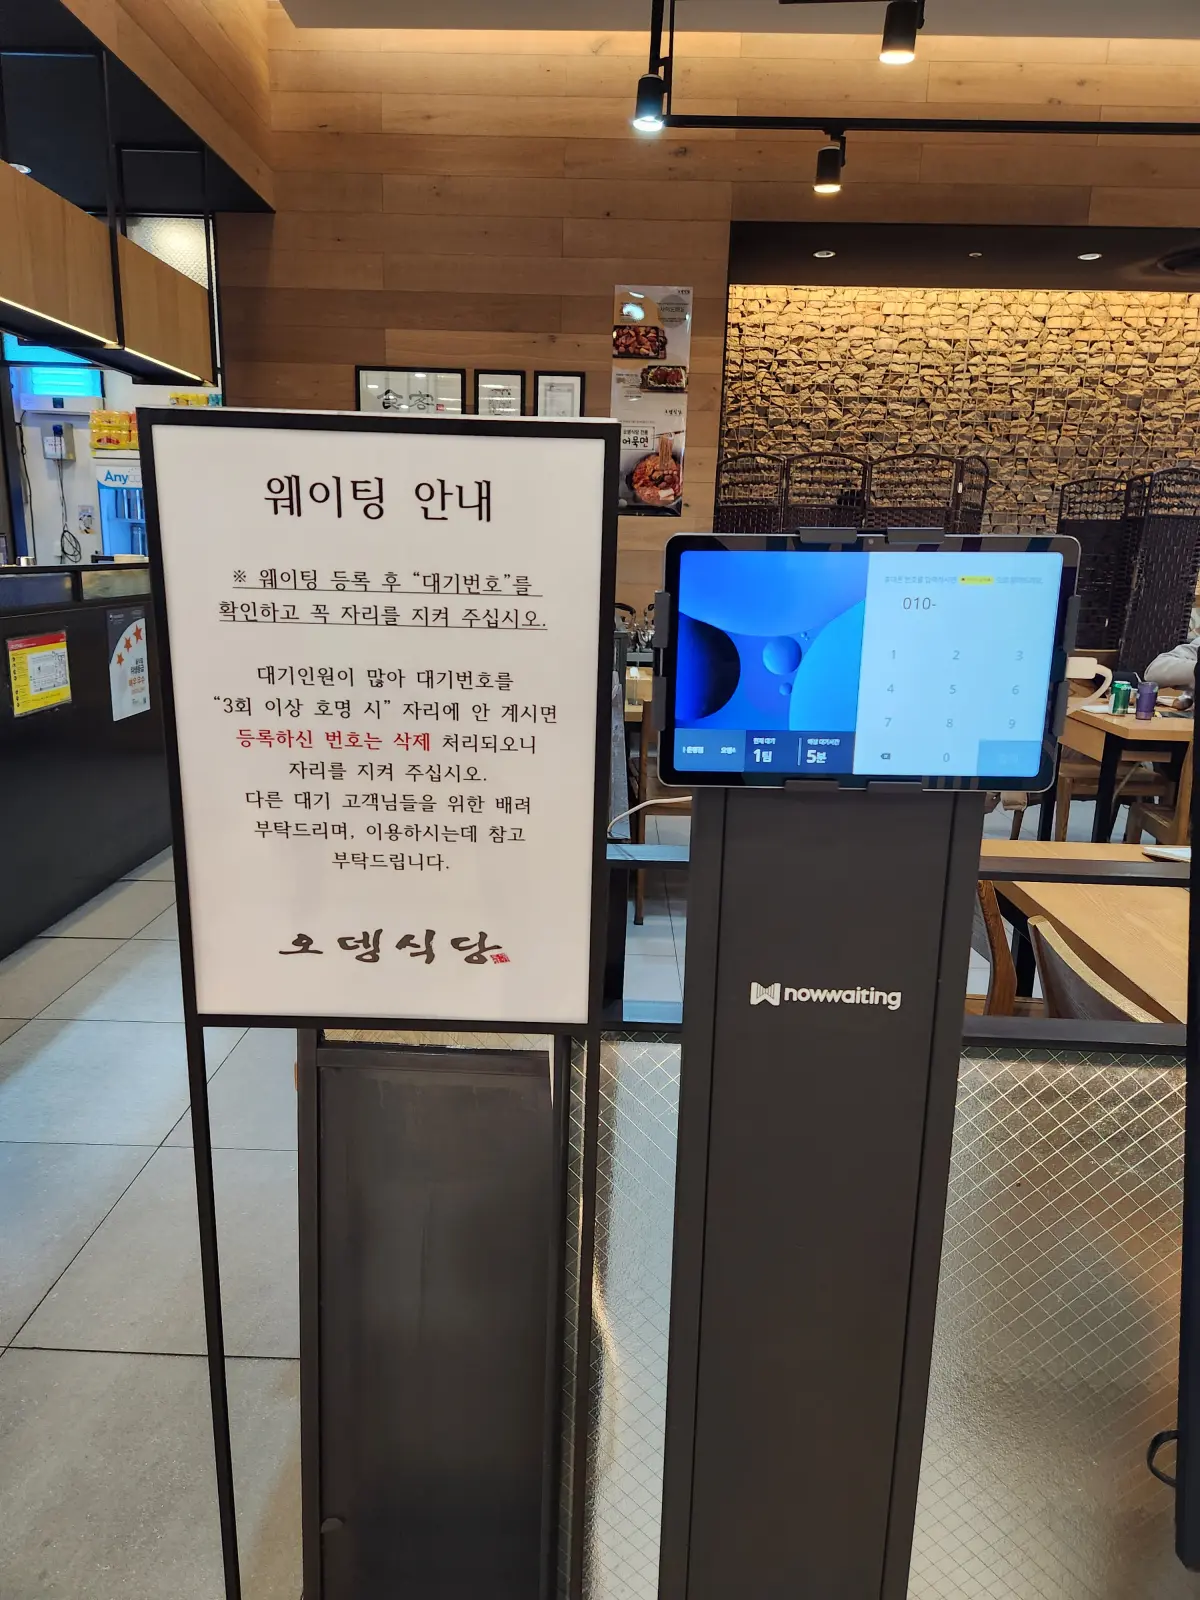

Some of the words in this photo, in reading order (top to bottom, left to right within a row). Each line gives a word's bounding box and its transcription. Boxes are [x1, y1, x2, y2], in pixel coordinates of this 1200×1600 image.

[263, 474, 385, 521] 웨이팅
[414, 478, 492, 523] 안내
[258, 568, 319, 590] 웨이팅
[329, 570, 371, 591] 등록
[381, 571, 402, 592] 후
[902, 597, 936, 610] 010-
[219, 600, 300, 622] 확인하고
[310, 604, 330, 624] 꼭
[341, 604, 401, 626] 자리를
[411, 606, 450, 628] 지켜
[461, 608, 546, 629] 주십시오.
[891, 649, 897, 660] 1
[952, 649, 960, 660] 2
[1015, 650, 1024, 661] 3
[257, 665, 354, 688] 대기인원이
[366, 667, 407, 689] 많아
[416, 669, 515, 692] 대기번호를
[886, 684, 894, 694] 4
[949, 684, 957, 695] 5
[1011, 684, 1020, 695] 6
[264, 697, 304, 718] 이상
[313, 699, 351, 720] 호명
[402, 700, 460, 722] 자리에
[471, 702, 491, 723] 안
[501, 703, 558, 724] 계시면
[884, 717, 892, 727] 7
[945, 718, 953, 728] 8
[1008, 719, 1016, 729] 9
[235, 728, 314, 749] 등록하신
[324, 729, 383, 751] 번호는
[393, 731, 431, 753] 삭제
[442, 733, 536, 755] 처리되오니
[753, 748, 773, 763] 1팀
[806, 749, 827, 764] 5분
[942, 752, 950, 762] 0
[288, 760, 347, 781] 자리를
[357, 761, 393, 782] 지켜
[404, 763, 487, 784] 주십시오.
[245, 789, 284, 809] 다른
[293, 791, 330, 811] 대기
[341, 792, 438, 813] 고객님들을
[447, 794, 486, 814] 위한
[495, 795, 531, 815] 배려
[254, 820, 355, 841] 부탁드리며,
[366, 822, 477, 843] 이용하시는데
[488, 825, 526, 844] 참고
[331, 851, 450, 872] 부탁드립니다.
[278, 928, 503, 965] 오뎅식당
[784, 986, 902, 1011] nowwaiting
